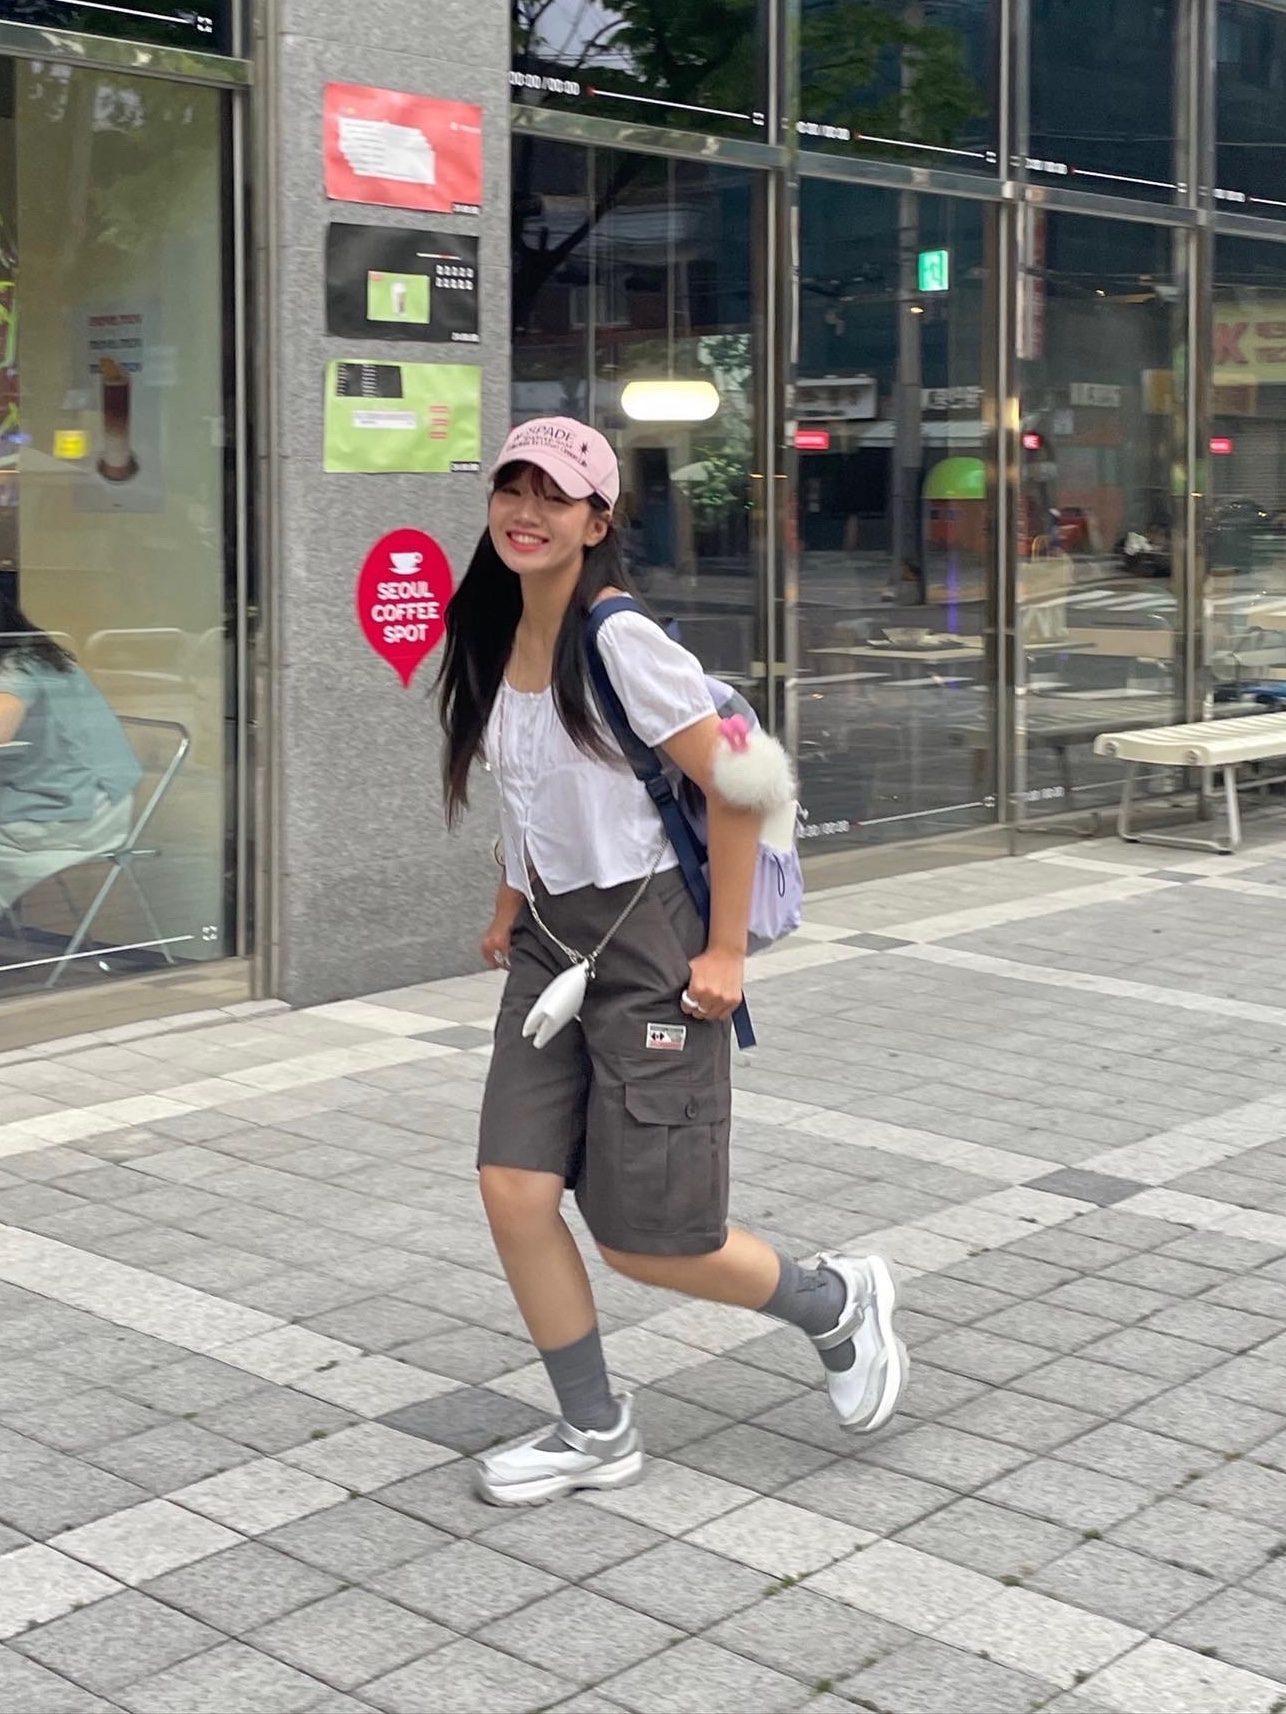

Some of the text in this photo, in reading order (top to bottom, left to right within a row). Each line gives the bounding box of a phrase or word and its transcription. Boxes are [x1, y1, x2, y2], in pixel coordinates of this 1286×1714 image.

[377, 581, 435, 600] SEOUL
[371, 602, 440, 622] COFFEE
[383, 624, 429, 643] SPOT
